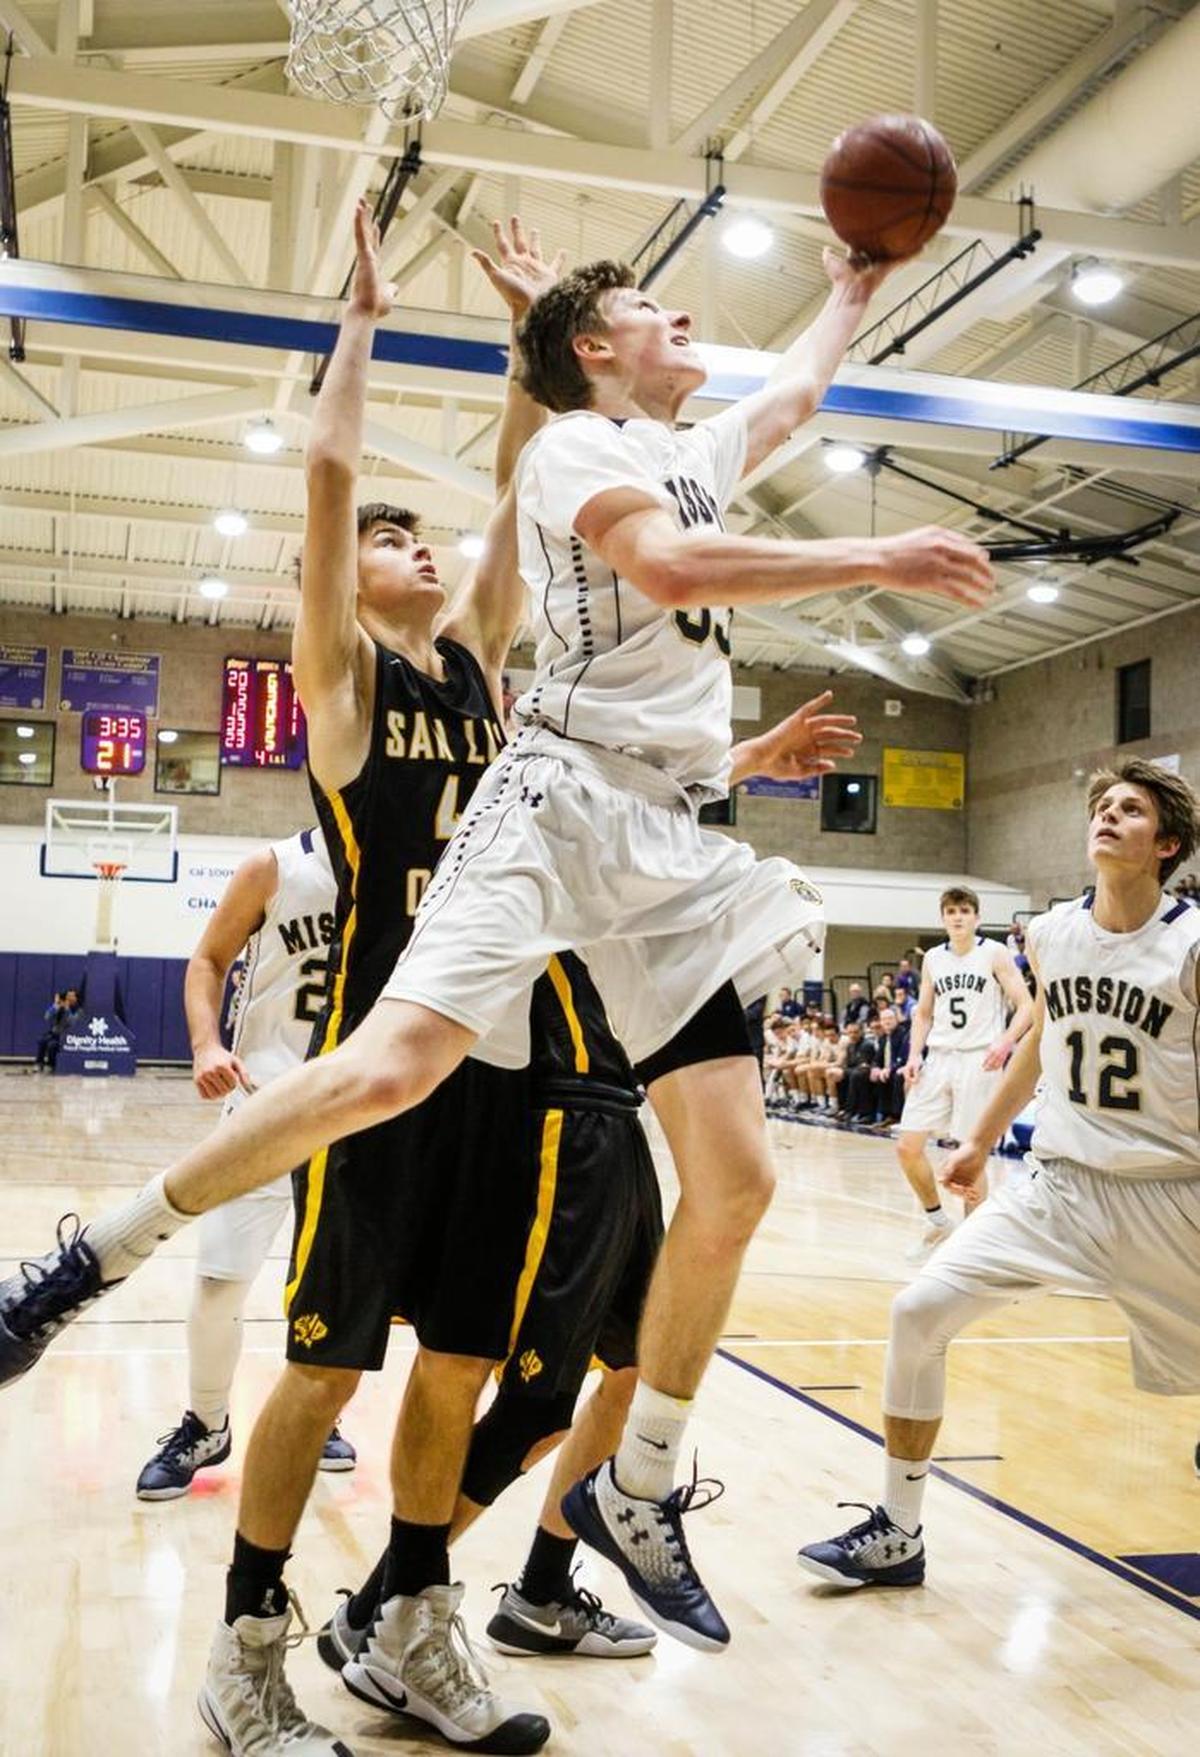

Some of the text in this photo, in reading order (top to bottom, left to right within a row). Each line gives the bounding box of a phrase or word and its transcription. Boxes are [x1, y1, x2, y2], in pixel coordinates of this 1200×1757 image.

[100, 717, 141, 738] 3:35
[386, 709, 455, 762] SAN
[97, 740, 130, 769] 21
[950, 996, 967, 1029] 5
[1044, 976, 1174, 1039] MISSION
[1065, 1030, 1141, 1111] 12
